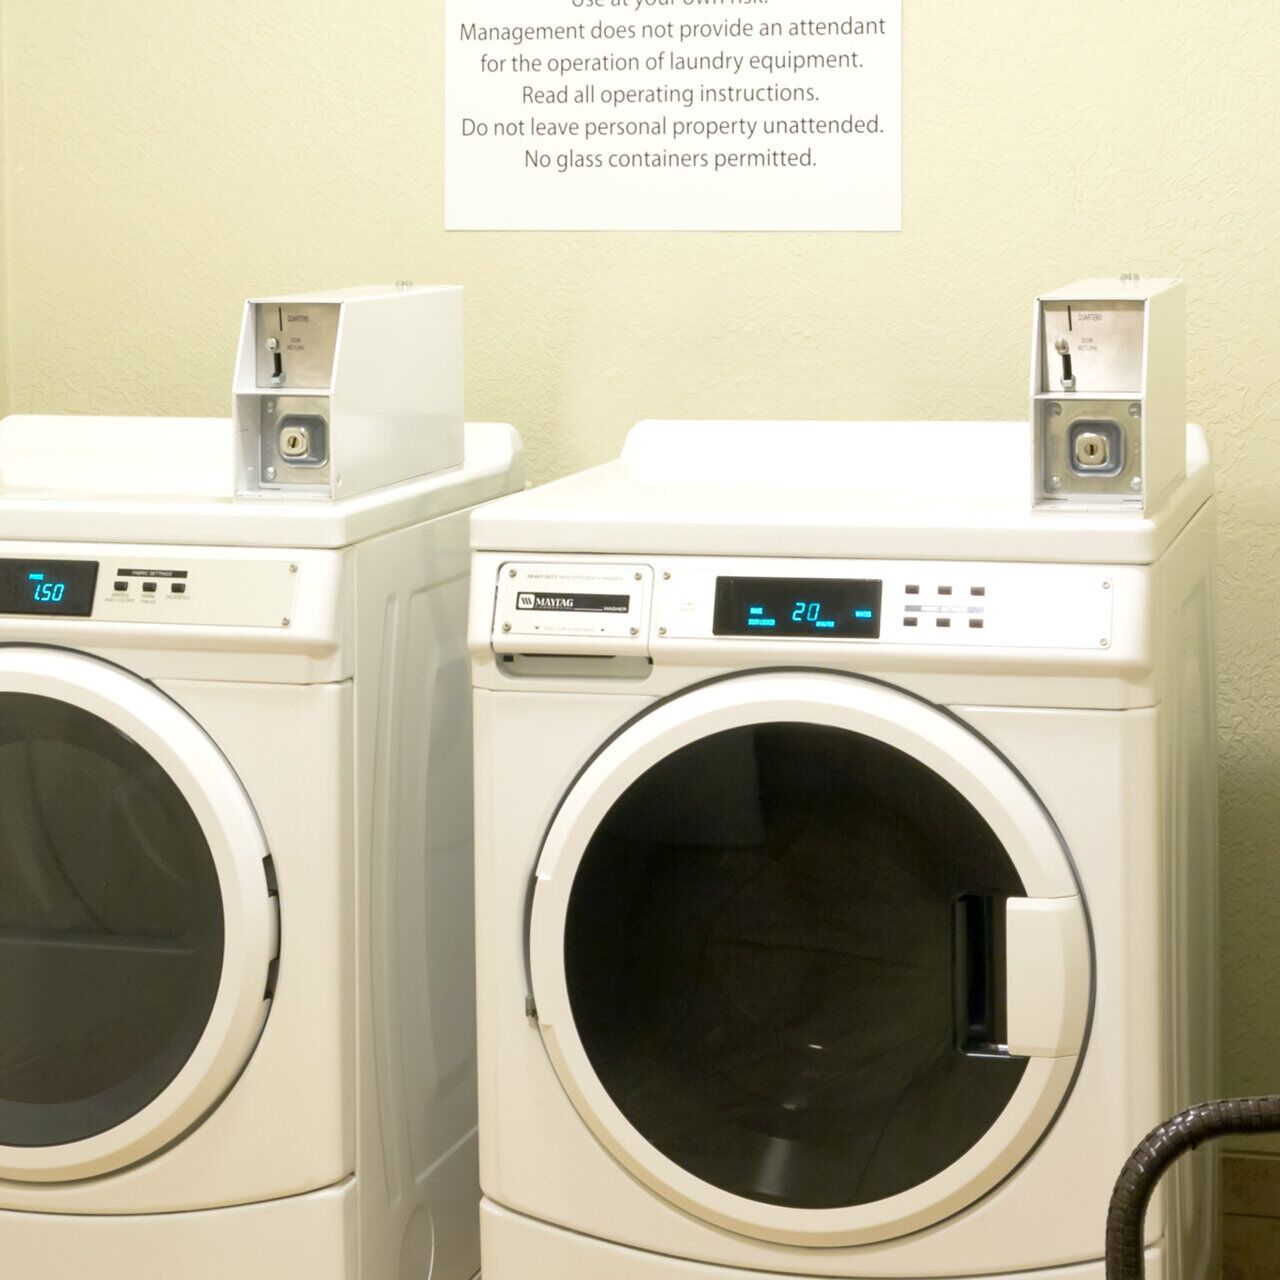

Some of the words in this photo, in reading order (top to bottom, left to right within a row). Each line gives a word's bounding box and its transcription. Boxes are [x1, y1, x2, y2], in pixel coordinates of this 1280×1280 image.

[460, 23, 585, 46] Management
[590, 20, 636, 40] does
[642, 21, 674, 38] not
[680, 17, 754, 43] provide
[759, 22, 782, 37] an
[788, 15, 886, 36] attendant
[480, 53, 507, 73] for
[511, 53, 542, 73] the
[547, 53, 639, 77] operation
[645, 50, 666, 71] of
[670, 50, 744, 75] laundry
[749, 50, 863, 74] equipment.
[522, 84, 568, 104] Read
[574, 84, 595, 104] all
[600, 84, 694, 108] operating
[700, 83, 819, 102] instructions.
[462, 118, 489, 137] Do
[494, 120, 525, 137] not
[531, 116, 580, 136] leave
[585, 115, 666, 140] personal
[673, 118, 758, 140] property
[763, 113, 884, 135] unattended.
[525, 149, 552, 168] No
[556, 148, 603, 173] glass
[608, 149, 709, 168] containers
[714, 147, 817, 172] permitted.
[1077, 313, 1103, 321] QUARTERS
[34, 583, 65, 602] 1.50
[535, 597, 574, 607] MAYTAG
[792, 602, 820, 622] 20
